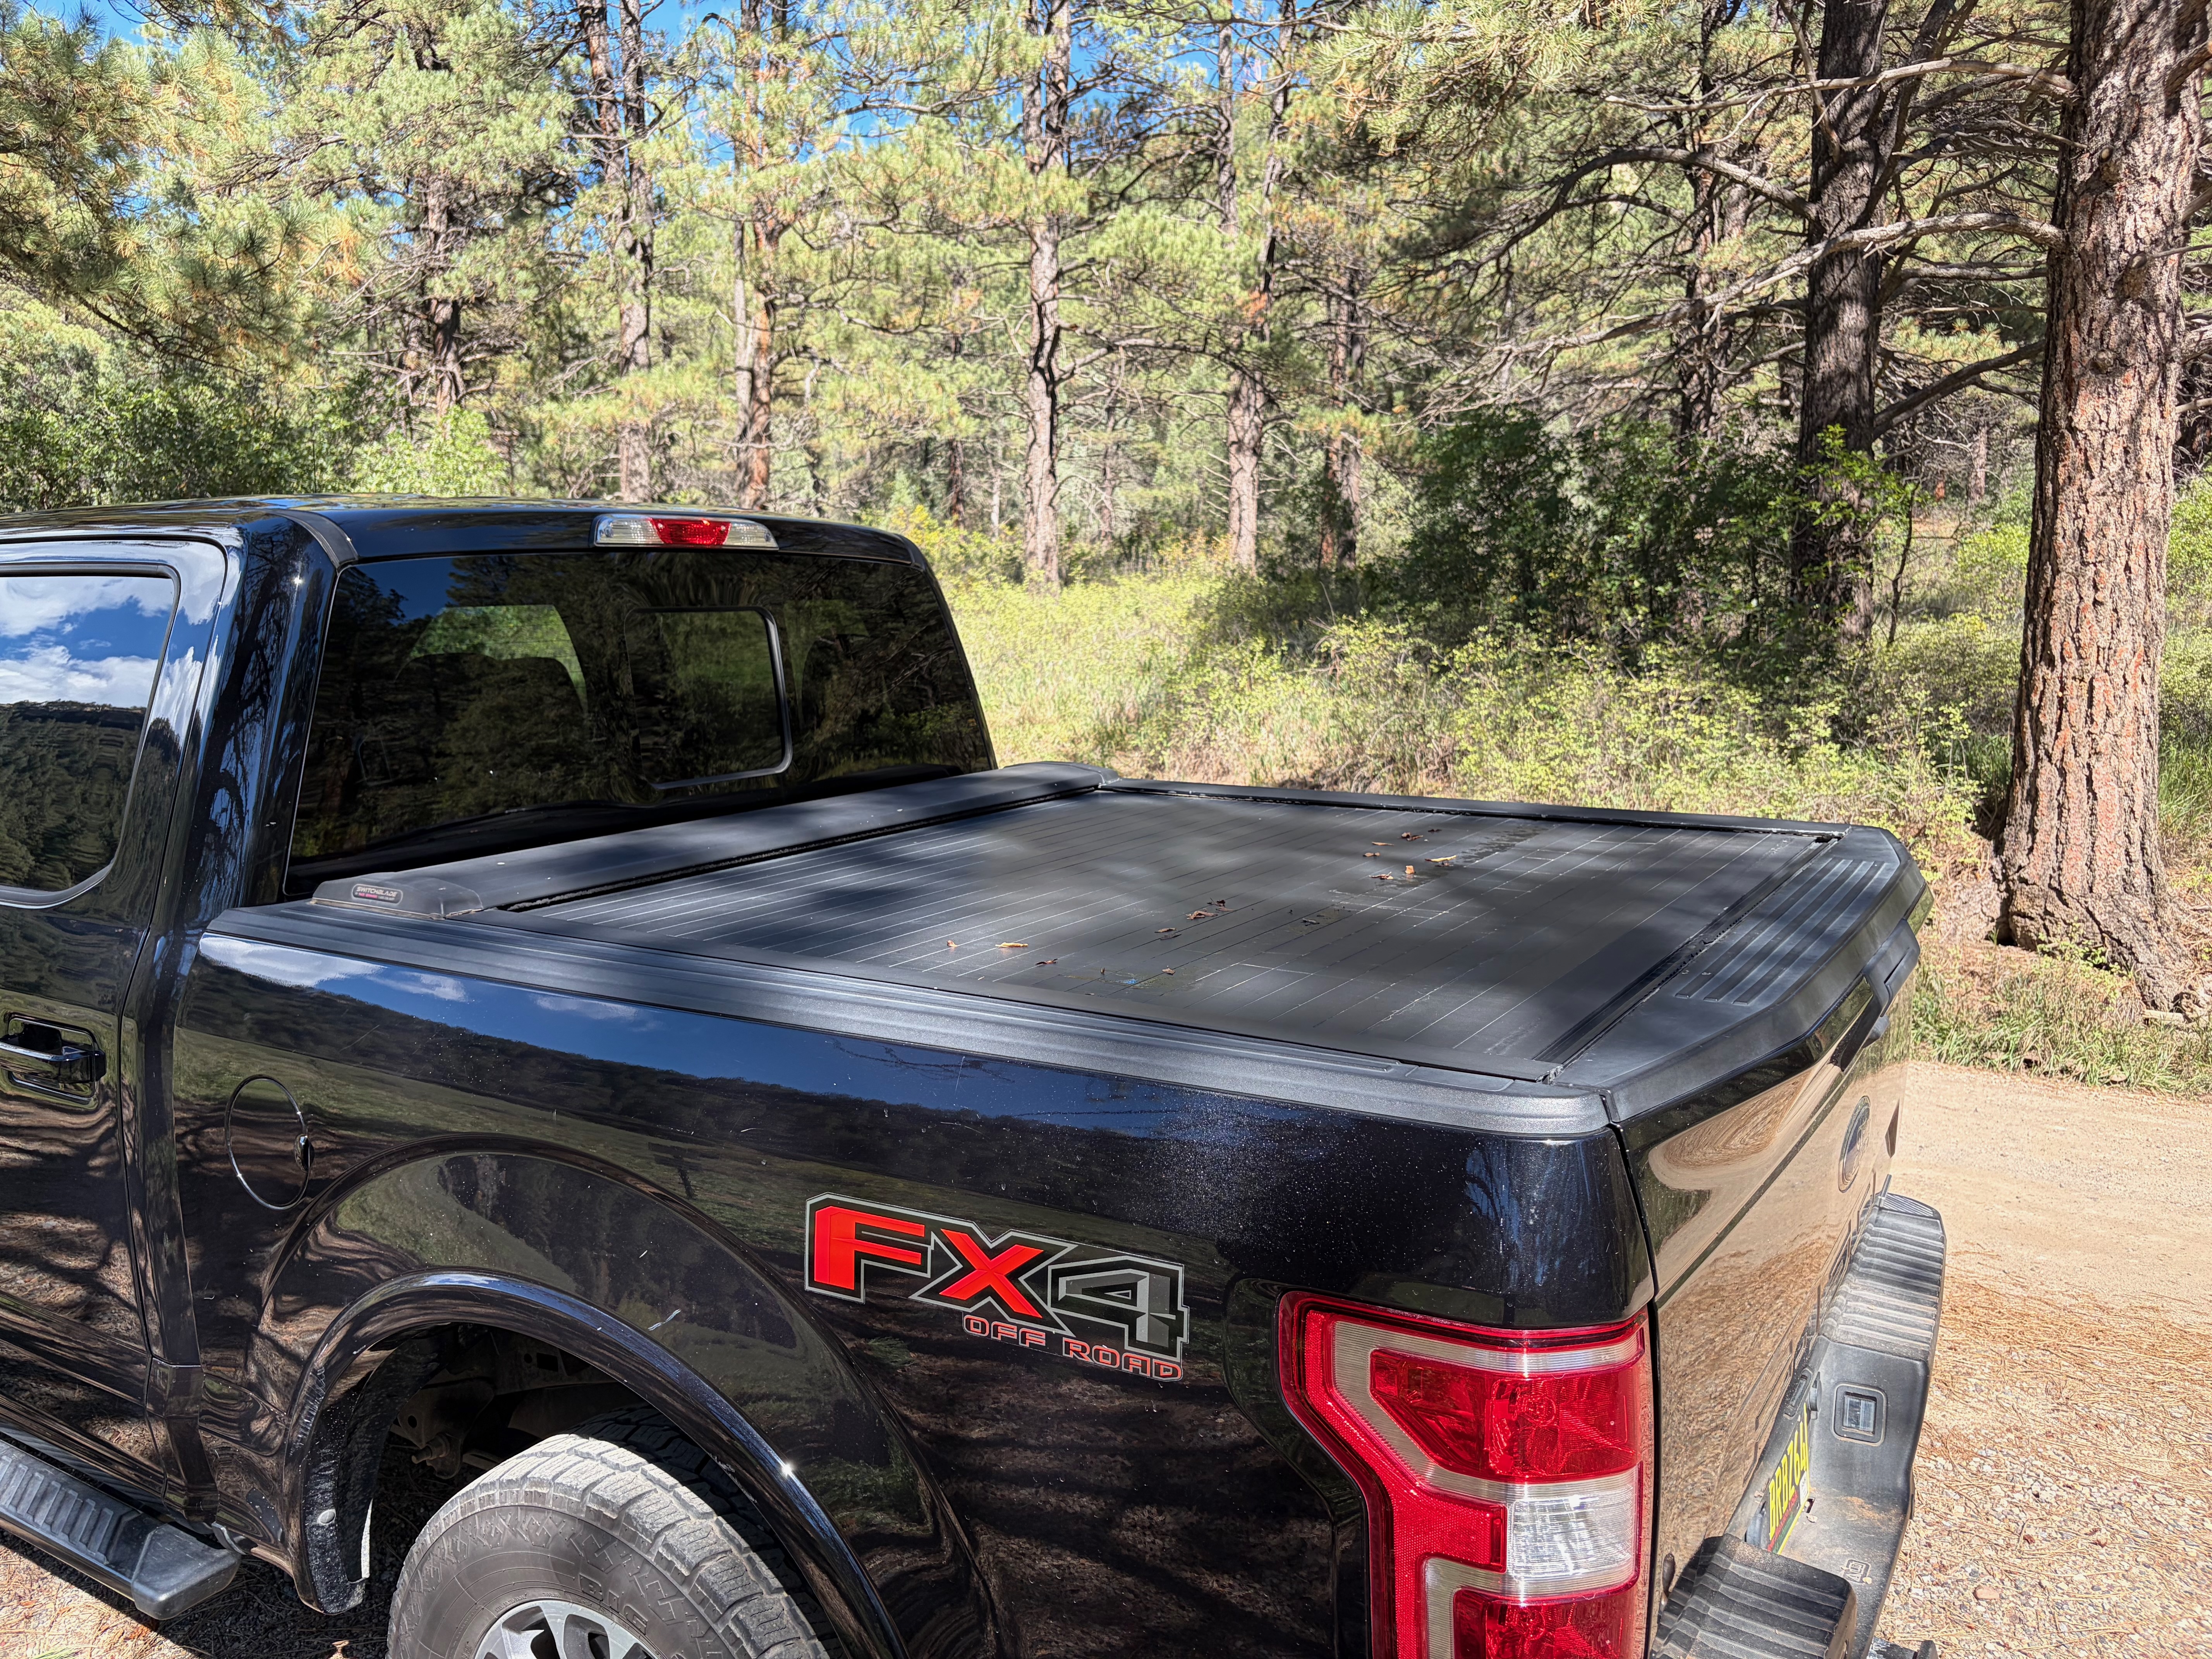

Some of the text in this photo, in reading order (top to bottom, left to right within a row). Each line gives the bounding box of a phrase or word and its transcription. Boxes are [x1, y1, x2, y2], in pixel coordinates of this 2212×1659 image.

[356, 886, 398, 897] SWITCHBLADE
[809, 1197, 1186, 1358] FX4
[963, 1315, 1183, 1381] OFF ROAD
[1769, 1421, 1806, 1540] BRBZ64
[579, 1573, 648, 1635] BIG
